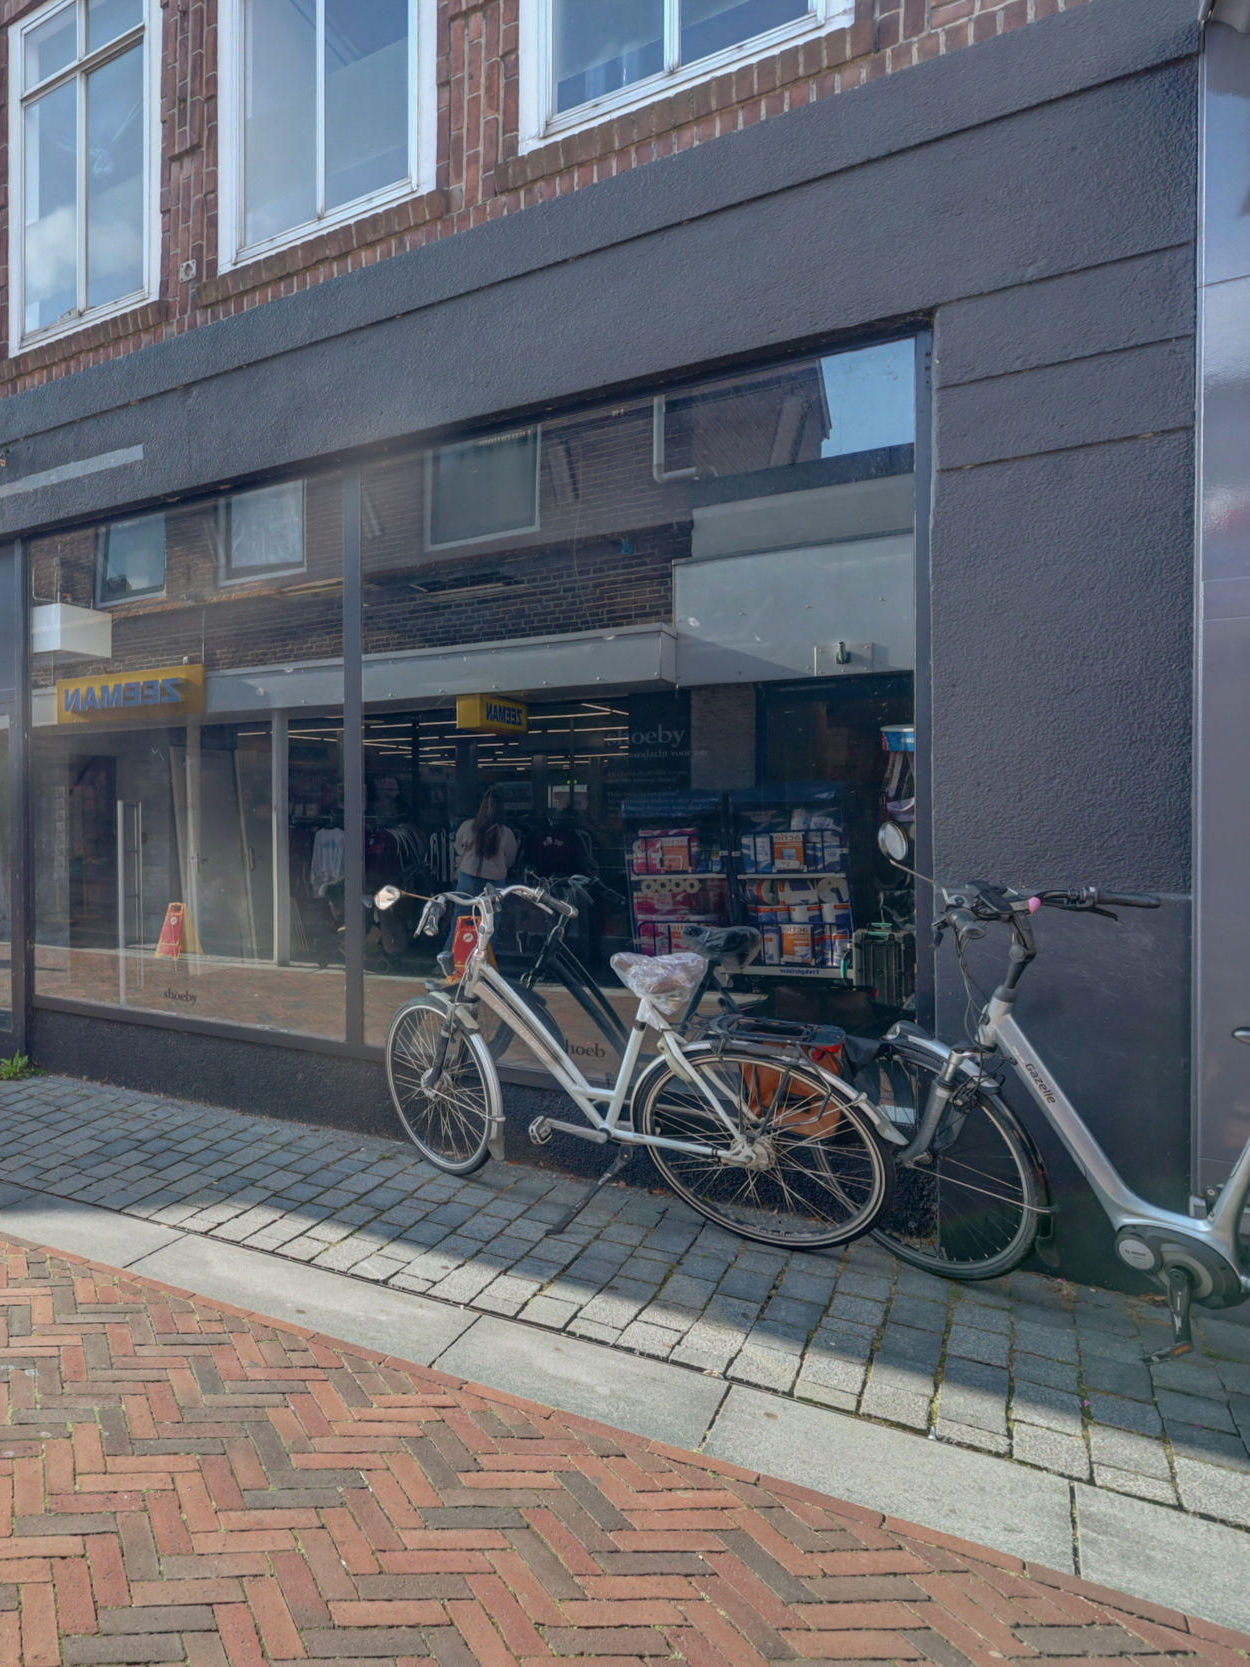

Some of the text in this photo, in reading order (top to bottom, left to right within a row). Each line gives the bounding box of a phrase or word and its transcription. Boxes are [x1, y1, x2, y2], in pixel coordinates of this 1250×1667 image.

[606, 723, 685, 748] shoeby
[629, 749, 669, 759] aandacht
[163, 987, 198, 1006] shoeby
[493, 1004, 538, 1048] GAZELLE
[1025, 1062, 1057, 1105] Gazelle
